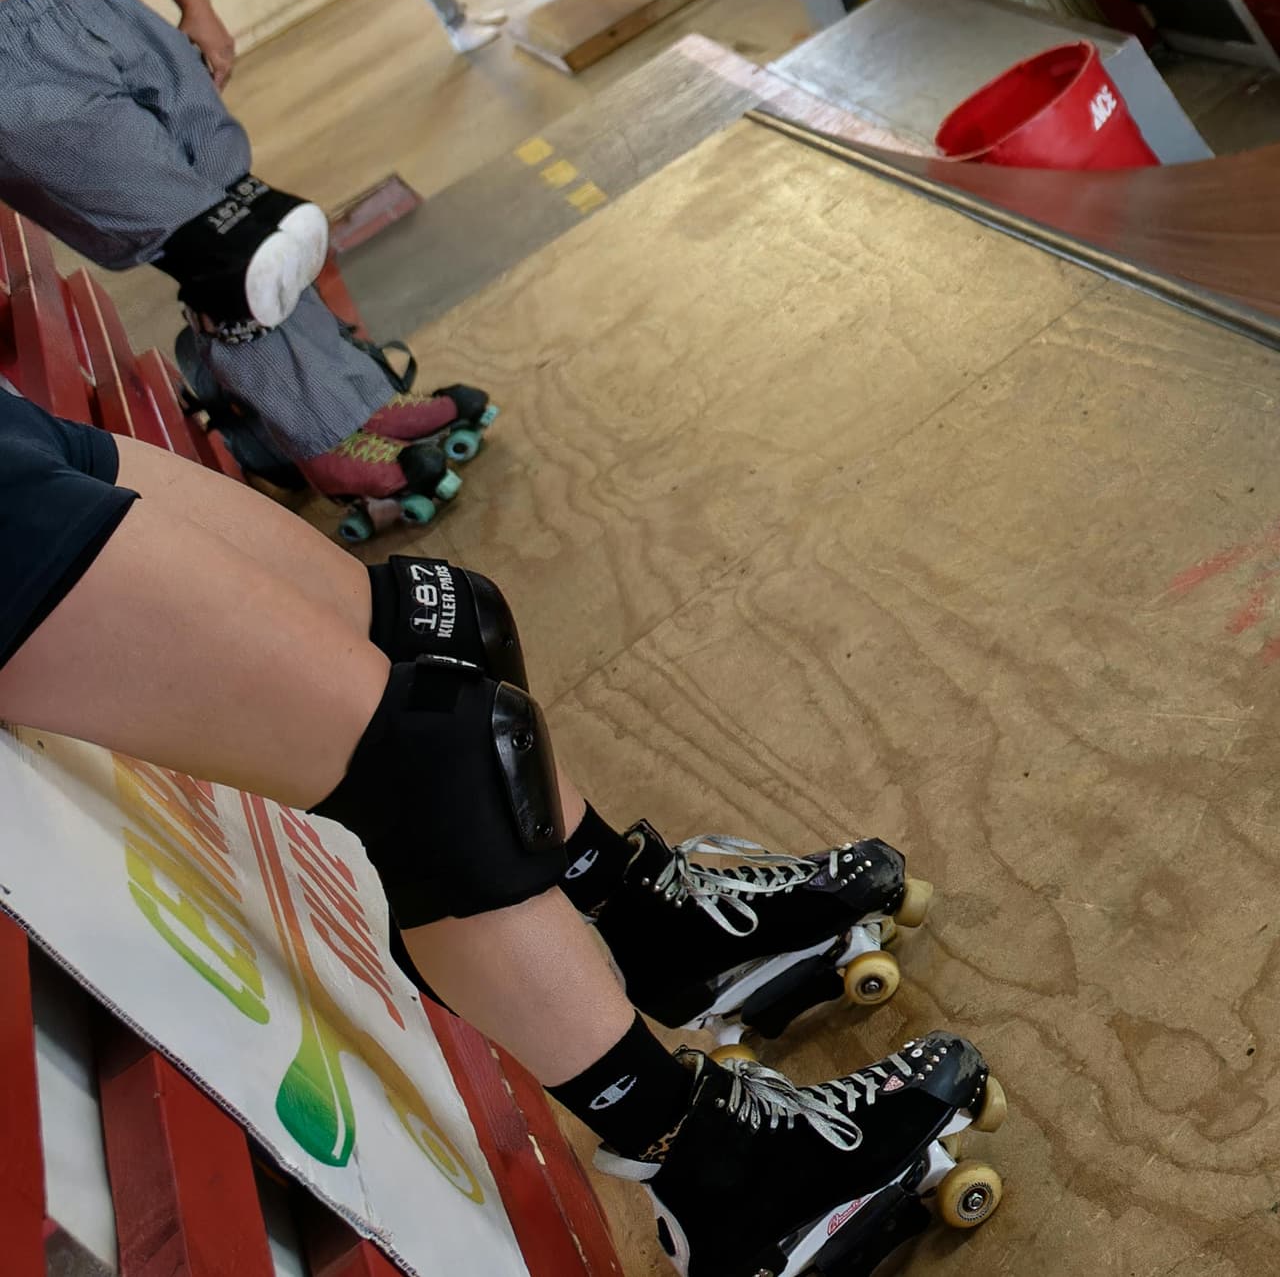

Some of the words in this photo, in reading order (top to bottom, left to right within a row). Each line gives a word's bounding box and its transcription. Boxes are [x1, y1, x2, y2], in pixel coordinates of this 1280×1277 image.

[1090, 84, 1118, 132] ACE
[409, 564, 438, 630] 187
[434, 565, 456, 592] PADS
[437, 593, 457, 639] KILLER
